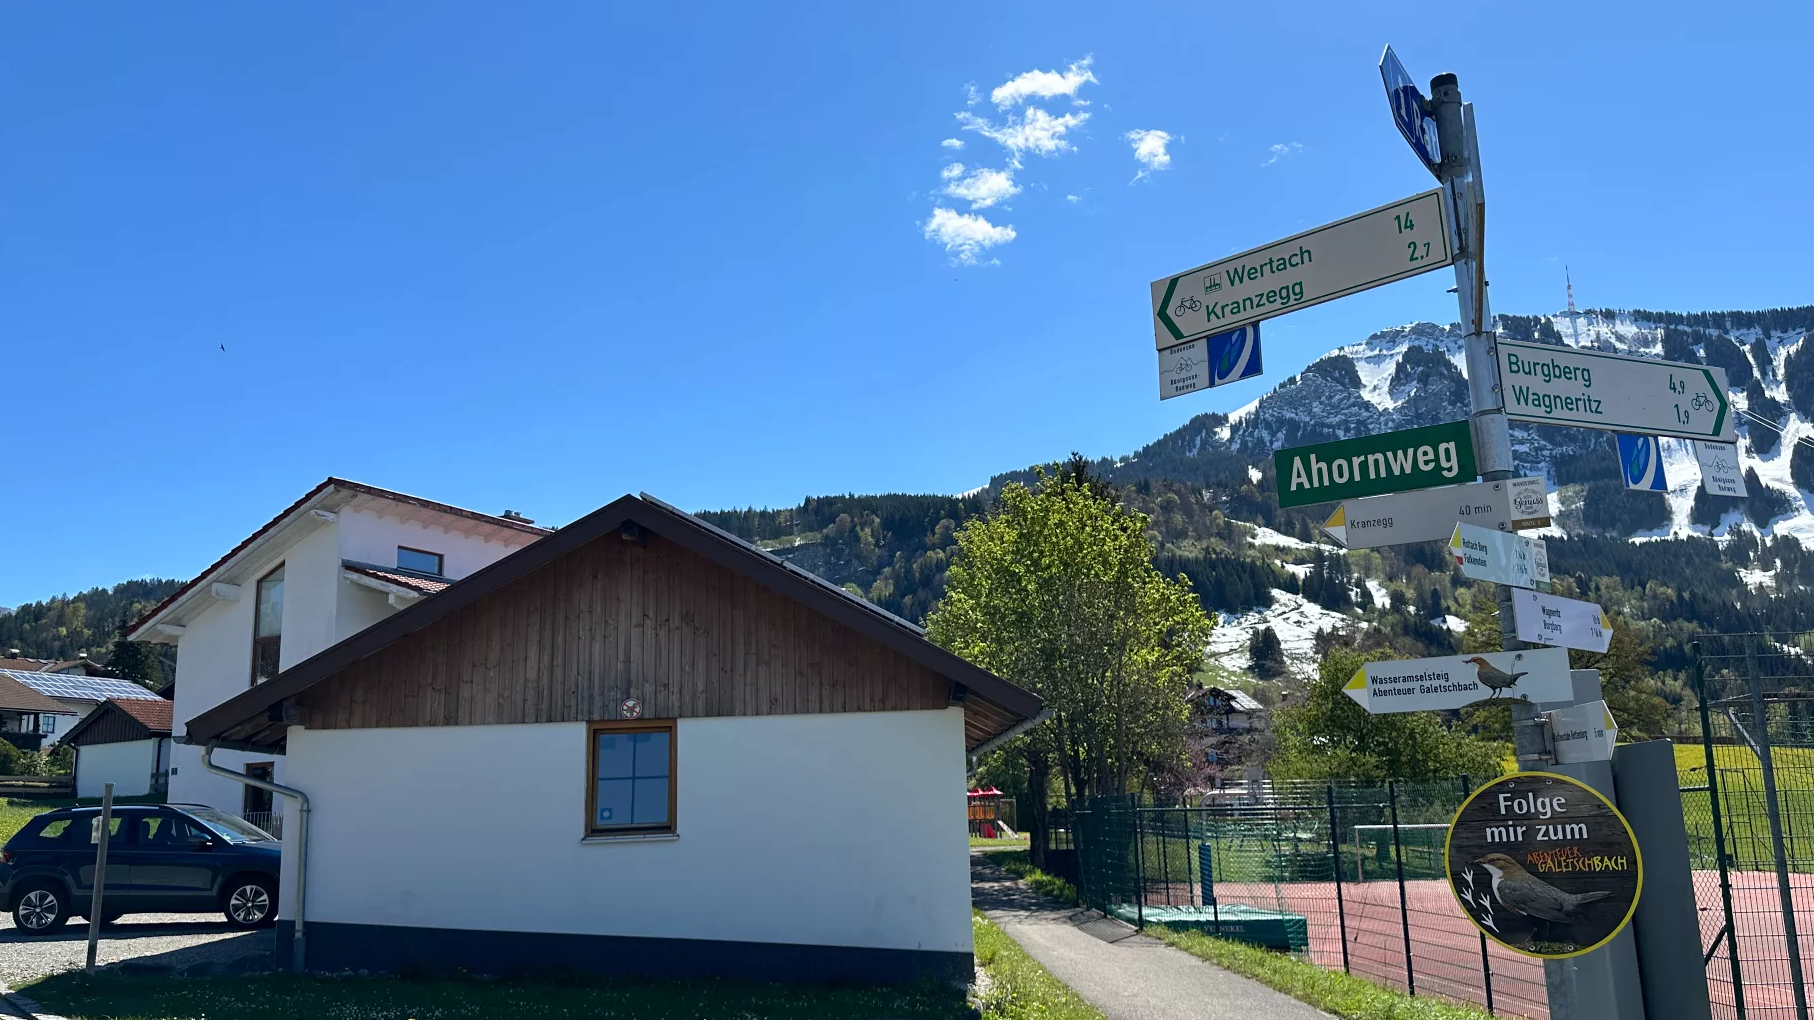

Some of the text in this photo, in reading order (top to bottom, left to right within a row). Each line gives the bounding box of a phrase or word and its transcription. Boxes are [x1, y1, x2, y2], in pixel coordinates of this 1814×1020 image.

[1393, 211, 1414, 235] 14
[1407, 241, 1431, 263] 2,7
[1226, 246, 1313, 287] Wertach
[1205, 280, 1305, 323] Kranzegg
[1507, 352, 1592, 389] Burgberg
[1668, 373, 1686, 395] 4,9
[1511, 384, 1603, 415] Wagneritz
[1673, 403, 1690, 425] 1,9
[1290, 440, 1459, 492] Ahornweg
[1458, 503, 1492, 516] 40 min
[1513, 496, 1544, 510] Genuss
[1350, 516, 1394, 530] Kranzegg
[1370, 670, 1449, 685] Wasseramselsteig
[1372, 680, 1479, 698] Abenteuer Galetschbach
[1498, 792, 1567, 819] Folge
[1485, 821, 1588, 842] mir zum
[1527, 846, 1582, 865] ABENTEUER
[1537, 856, 1627, 872] GALETSCHBACH
